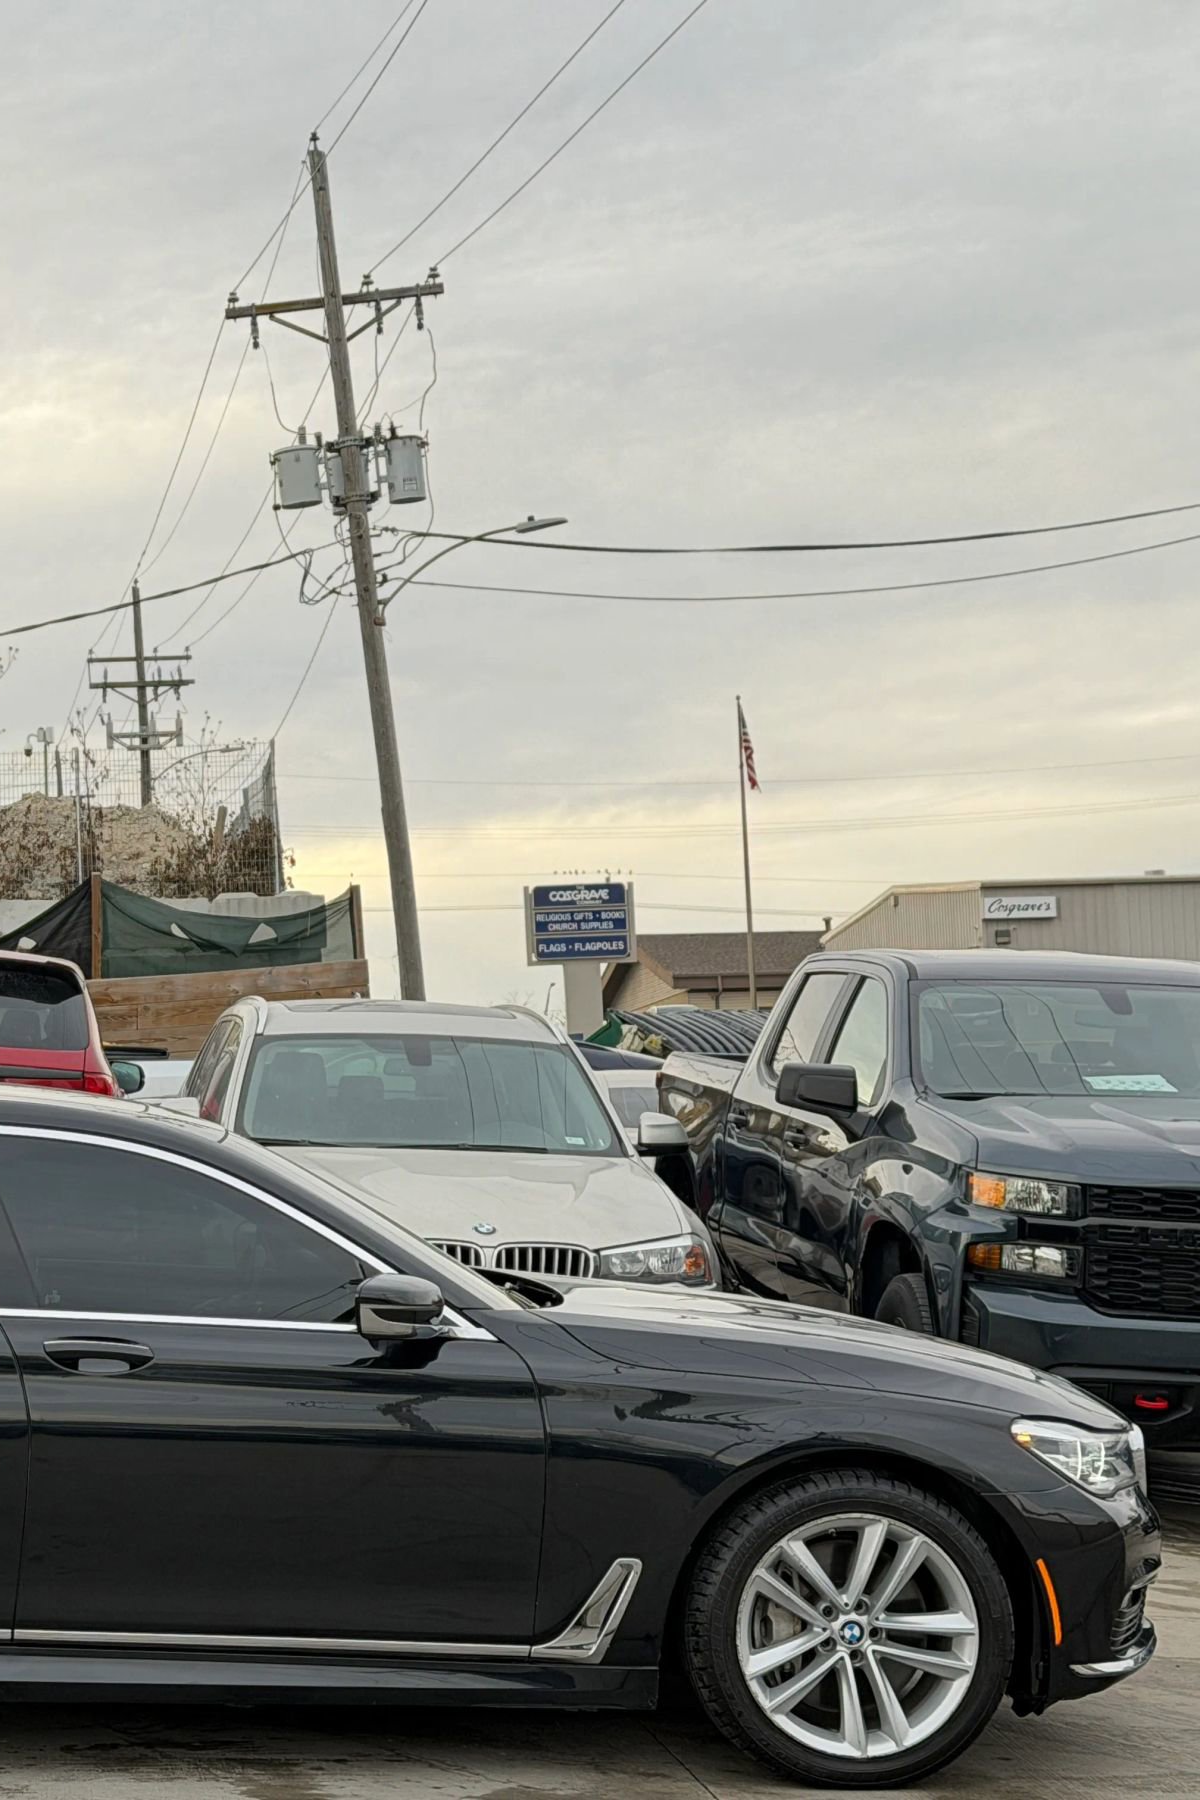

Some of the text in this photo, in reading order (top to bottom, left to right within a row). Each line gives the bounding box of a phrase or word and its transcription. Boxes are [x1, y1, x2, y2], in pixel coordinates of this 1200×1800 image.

[548, 889, 610, 902] COSGRAVE
[987, 898, 1052, 917] Cosgrave's
[536, 911, 625, 922] RELIGIOUS GIFTS BOOKS
[548, 921, 614, 931] CHURCH SUPPLIES
[538, 940, 625, 953] FLAGS FLAGPOLES
